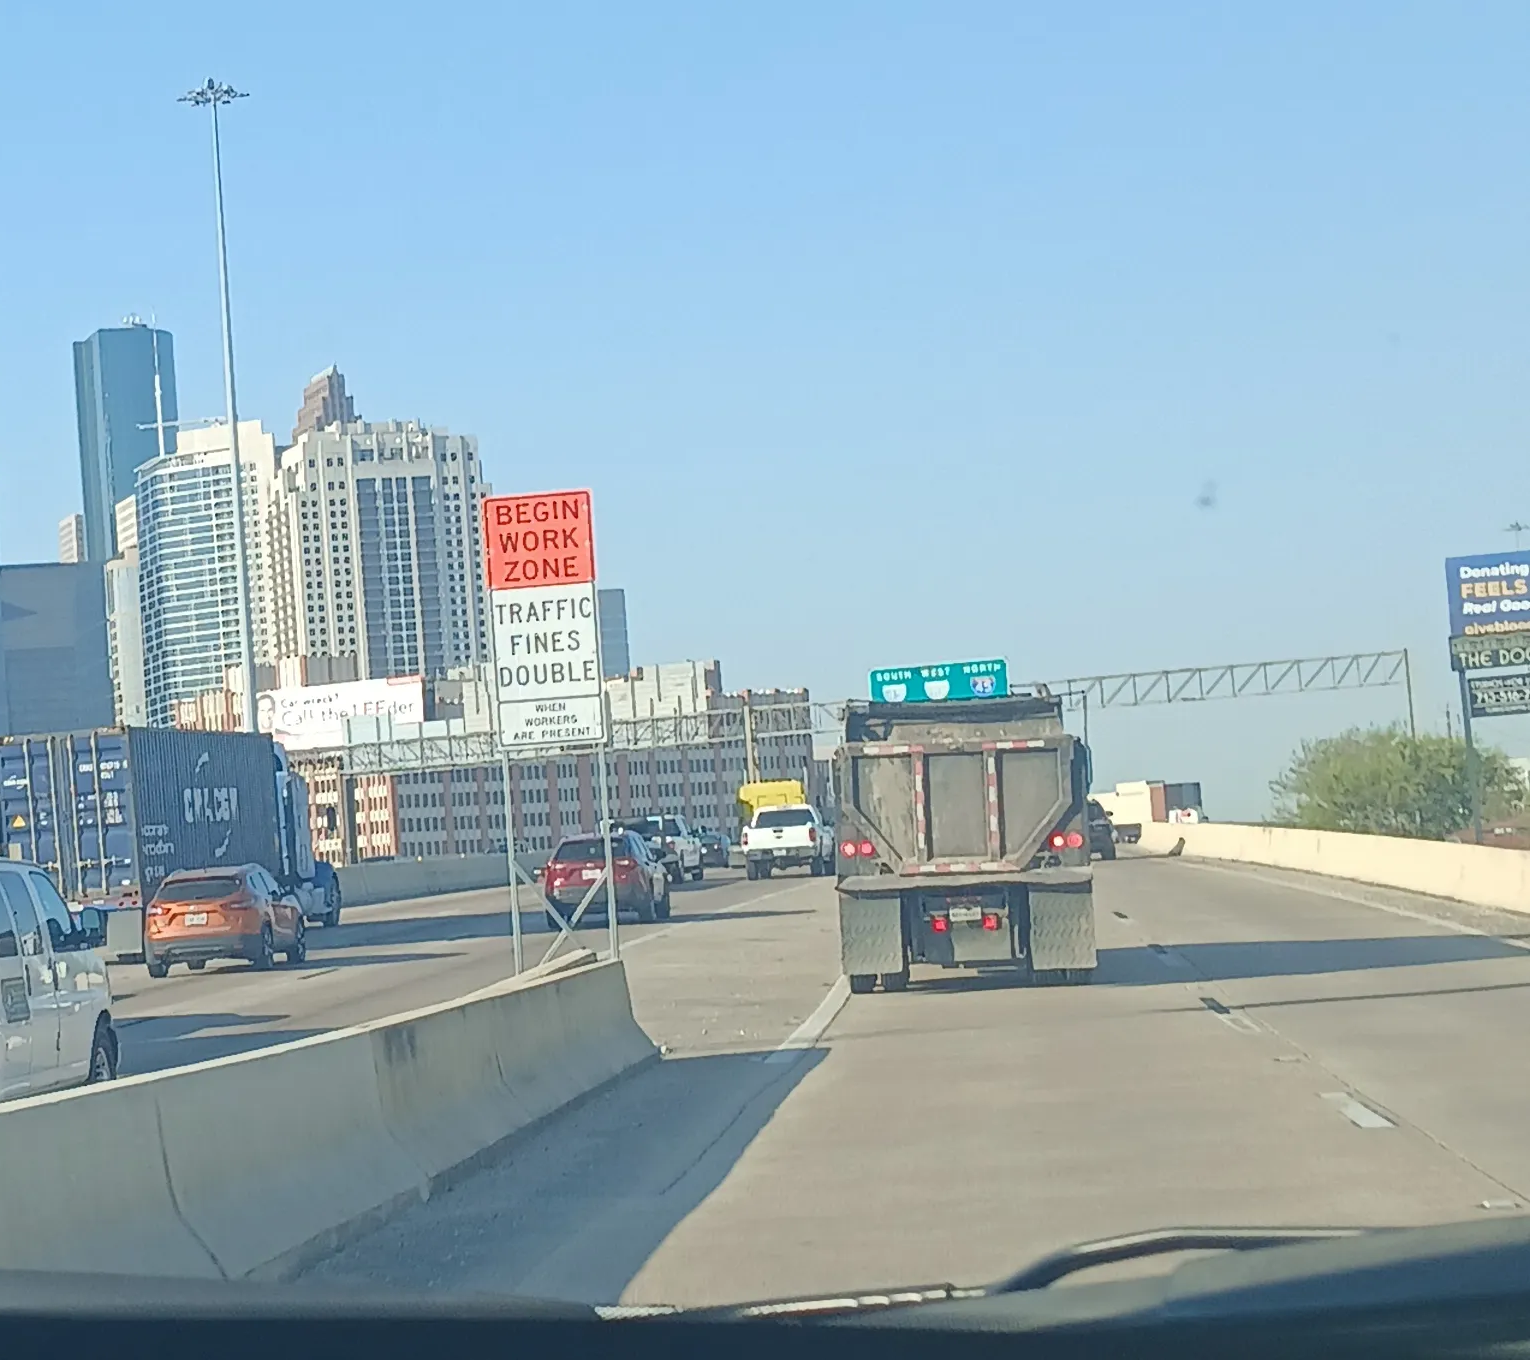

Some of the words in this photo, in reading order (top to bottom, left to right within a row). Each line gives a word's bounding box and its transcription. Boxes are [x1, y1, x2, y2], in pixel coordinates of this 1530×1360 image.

[496, 498, 579, 525] BEGIN
[499, 527, 579, 553] WORK
[504, 555, 579, 583] ZONE
[1459, 561, 1530, 579] Donating
[1461, 578, 1528, 599] FEELS
[495, 596, 592, 625] TRAFFIC
[510, 630, 580, 655] FINES
[1458, 650, 1493, 668] THE
[499, 660, 595, 688] DOUBLE
[535, 702, 566, 713] WHEN
[282, 710, 313, 727] Call
[524, 714, 578, 727] WORKERS
[513, 730, 536, 741] ARE
[541, 726, 591, 739] PRESENT
